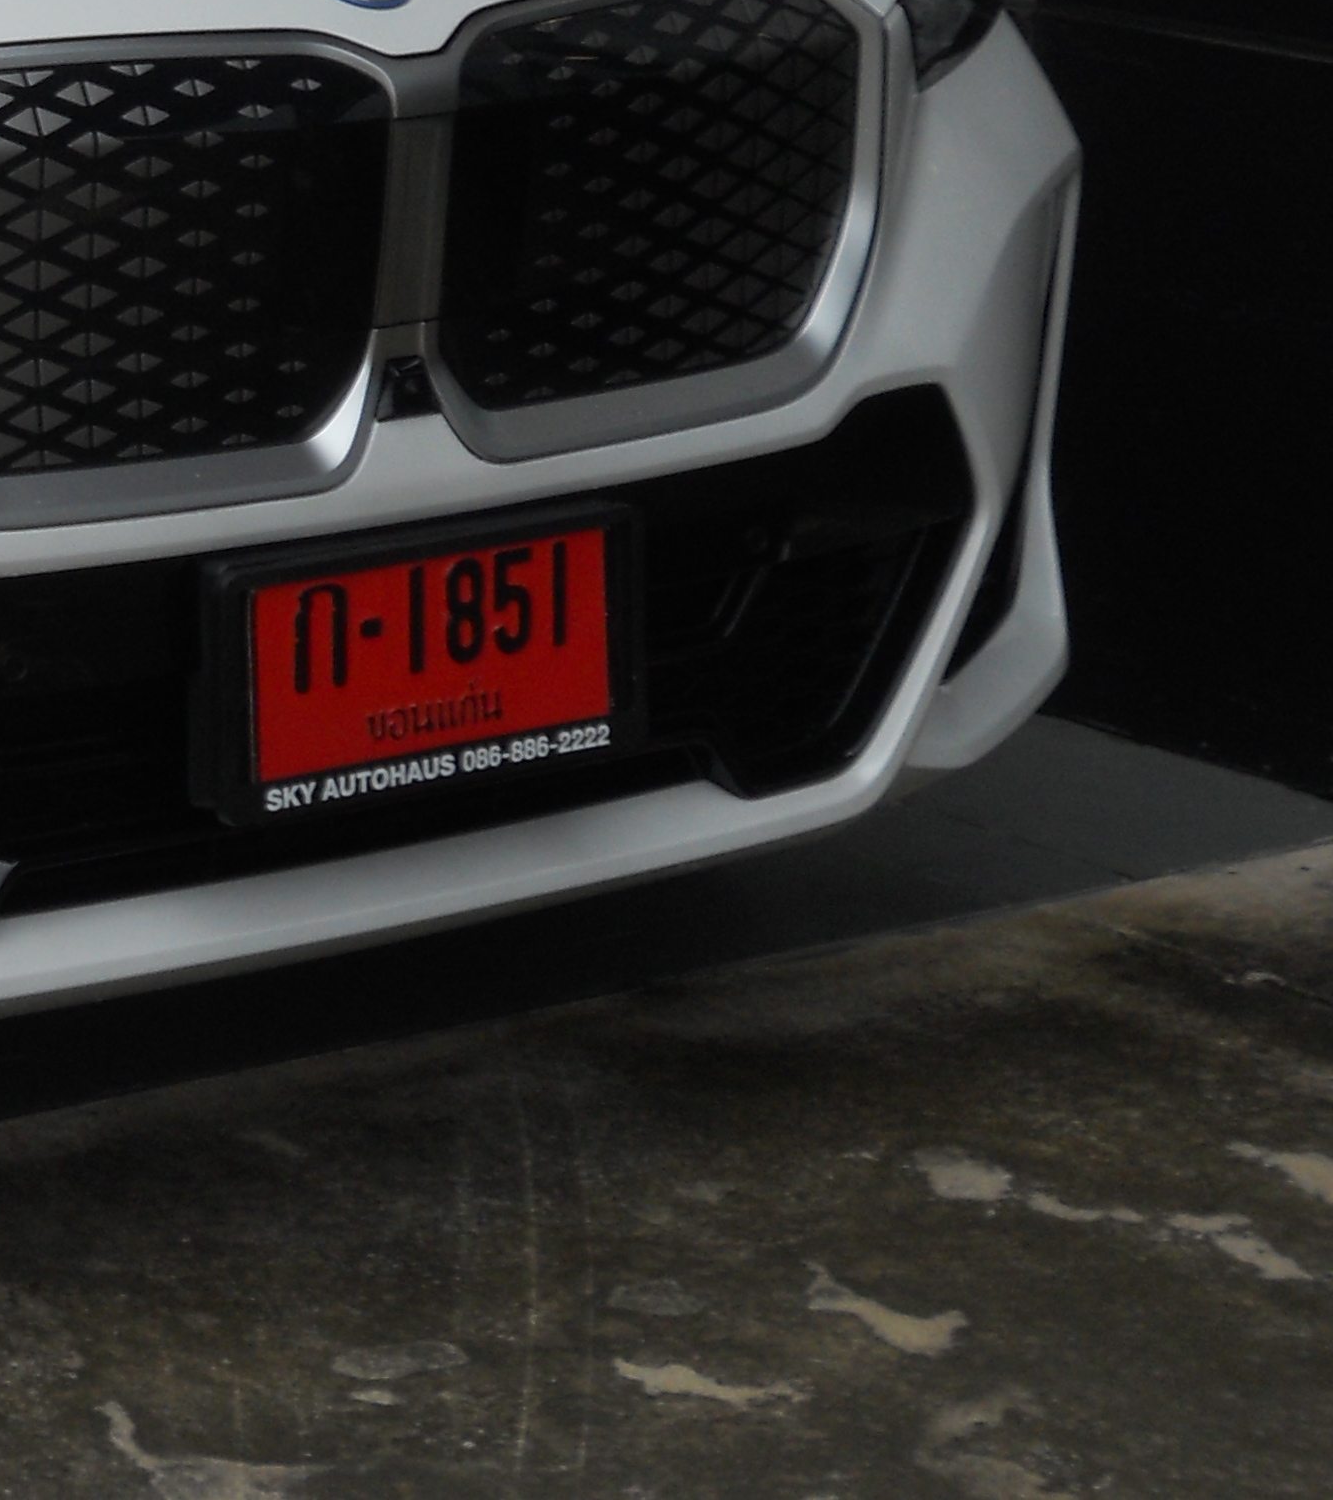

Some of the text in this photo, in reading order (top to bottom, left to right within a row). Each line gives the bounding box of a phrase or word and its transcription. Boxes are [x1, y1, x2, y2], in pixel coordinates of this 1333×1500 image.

[294, 540, 567, 694] ก-1851
[366, 682, 504, 741] ขอนแก่น
[266, 724, 611, 812] SKY AUTOHAUS 086-886-2222
